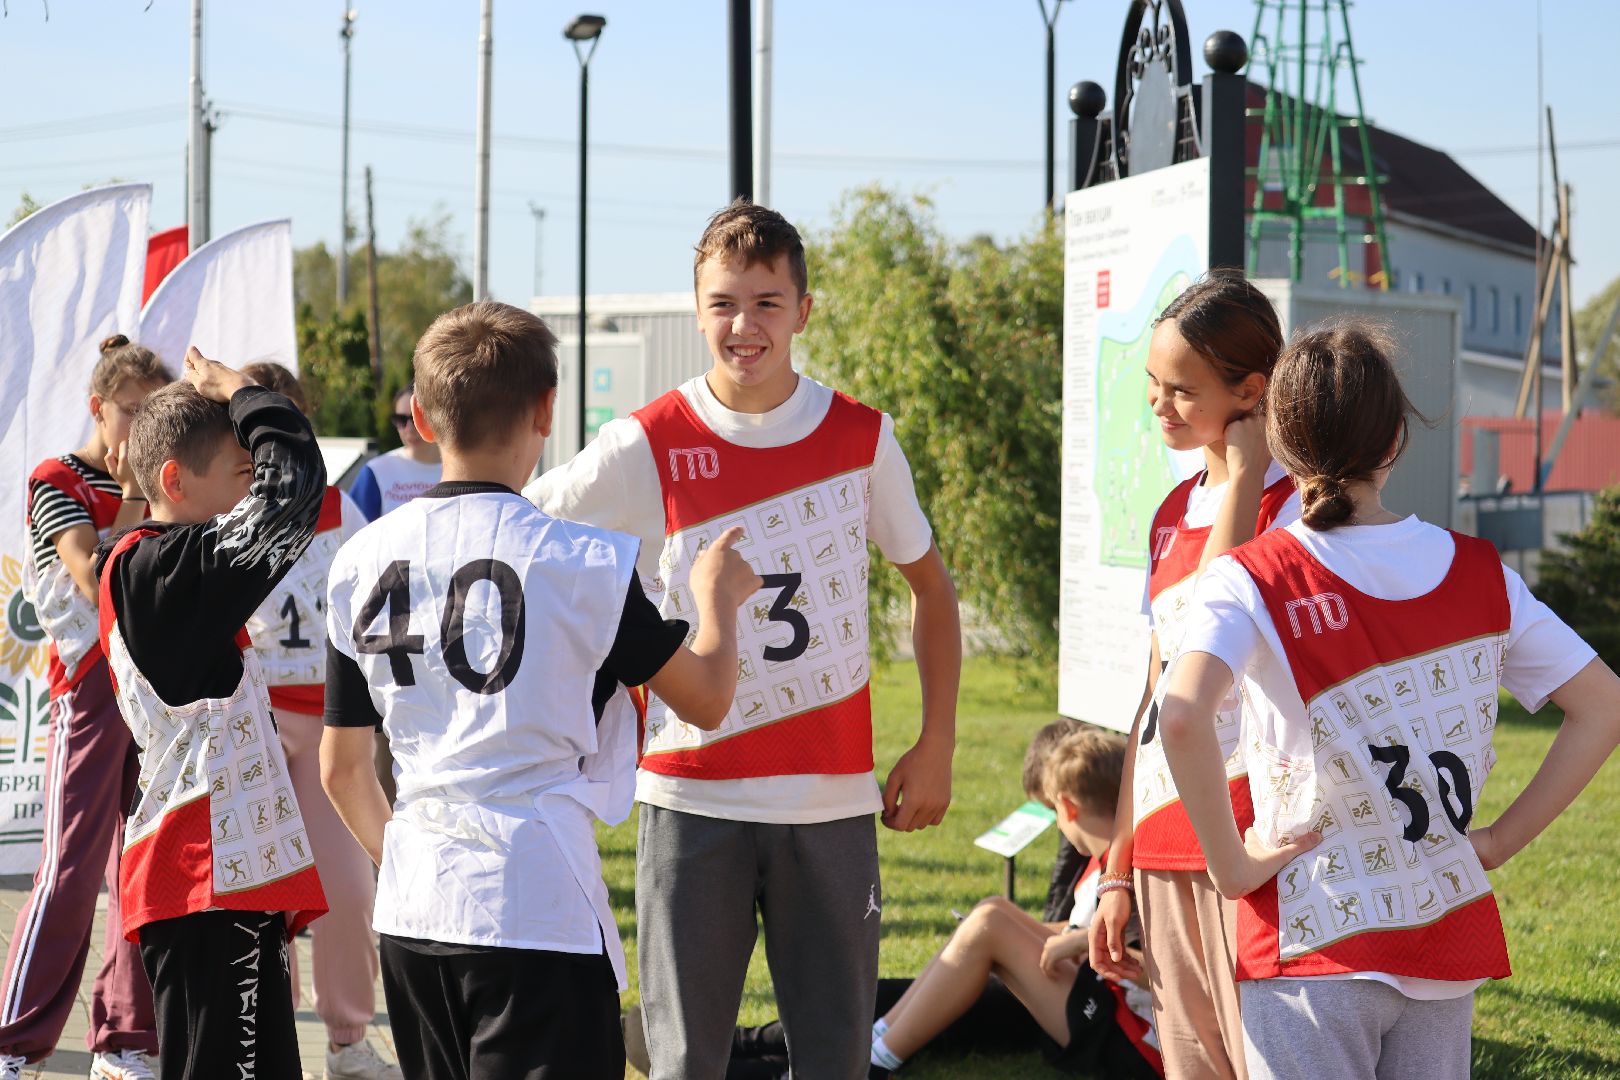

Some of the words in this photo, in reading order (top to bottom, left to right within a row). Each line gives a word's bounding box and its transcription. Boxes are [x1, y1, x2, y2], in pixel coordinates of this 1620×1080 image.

[668, 446, 720, 482] ГТО
[1152, 525, 1178, 561] ТО
[352, 558, 526, 695] 40
[1284, 592, 1349, 639] ГТО
[0, 774, 46, 793] БРЯ
[1368, 744, 1473, 843] 30
[13, 802, 45, 819] ПР
